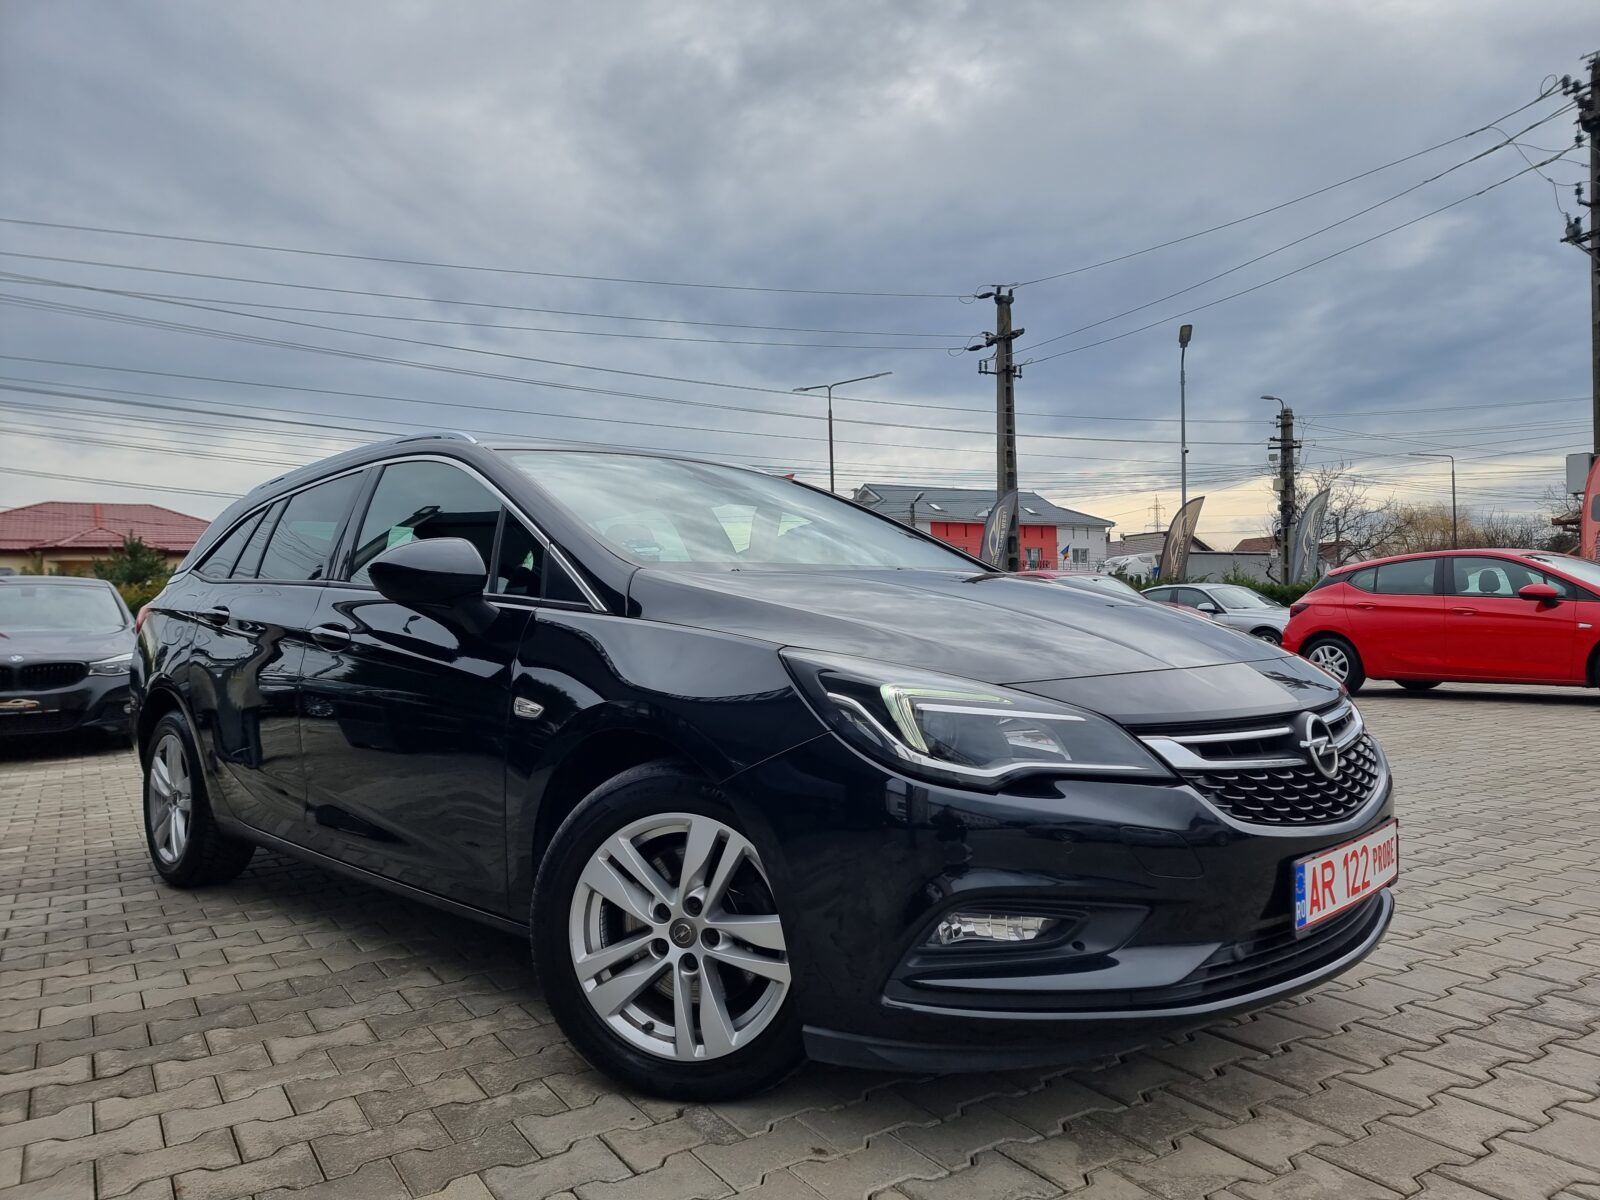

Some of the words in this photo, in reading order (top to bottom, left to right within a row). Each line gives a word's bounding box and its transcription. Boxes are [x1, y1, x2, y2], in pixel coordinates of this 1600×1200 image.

[1309, 860, 1336, 916] AR
[1343, 845, 1371, 898] 122
[1372, 837, 1395, 876] PROBE
[1296, 899, 1306, 921] RO
